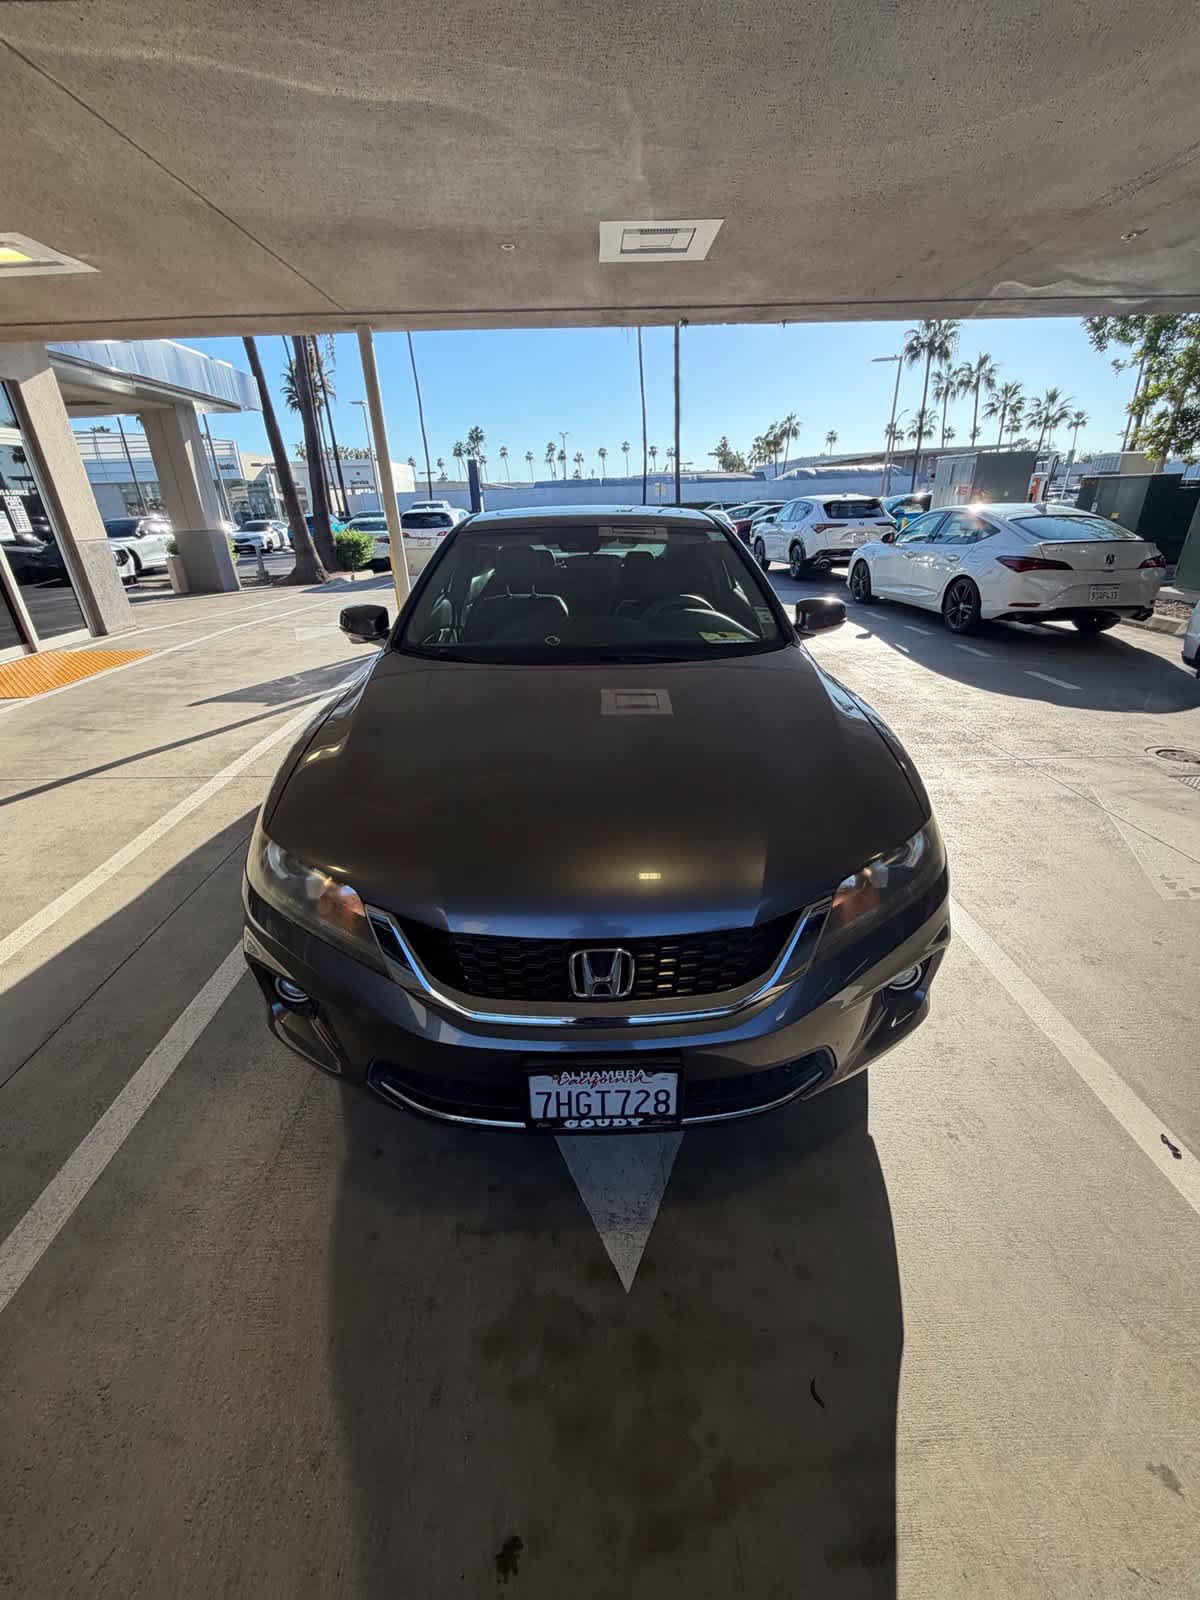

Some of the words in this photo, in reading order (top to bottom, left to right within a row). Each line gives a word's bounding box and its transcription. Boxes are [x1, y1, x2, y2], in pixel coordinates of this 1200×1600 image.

[560, 1069, 646, 1080] ALHAMBRA
[535, 1089, 671, 1118] 7HGT728
[563, 1117, 644, 1129] GOUDY
